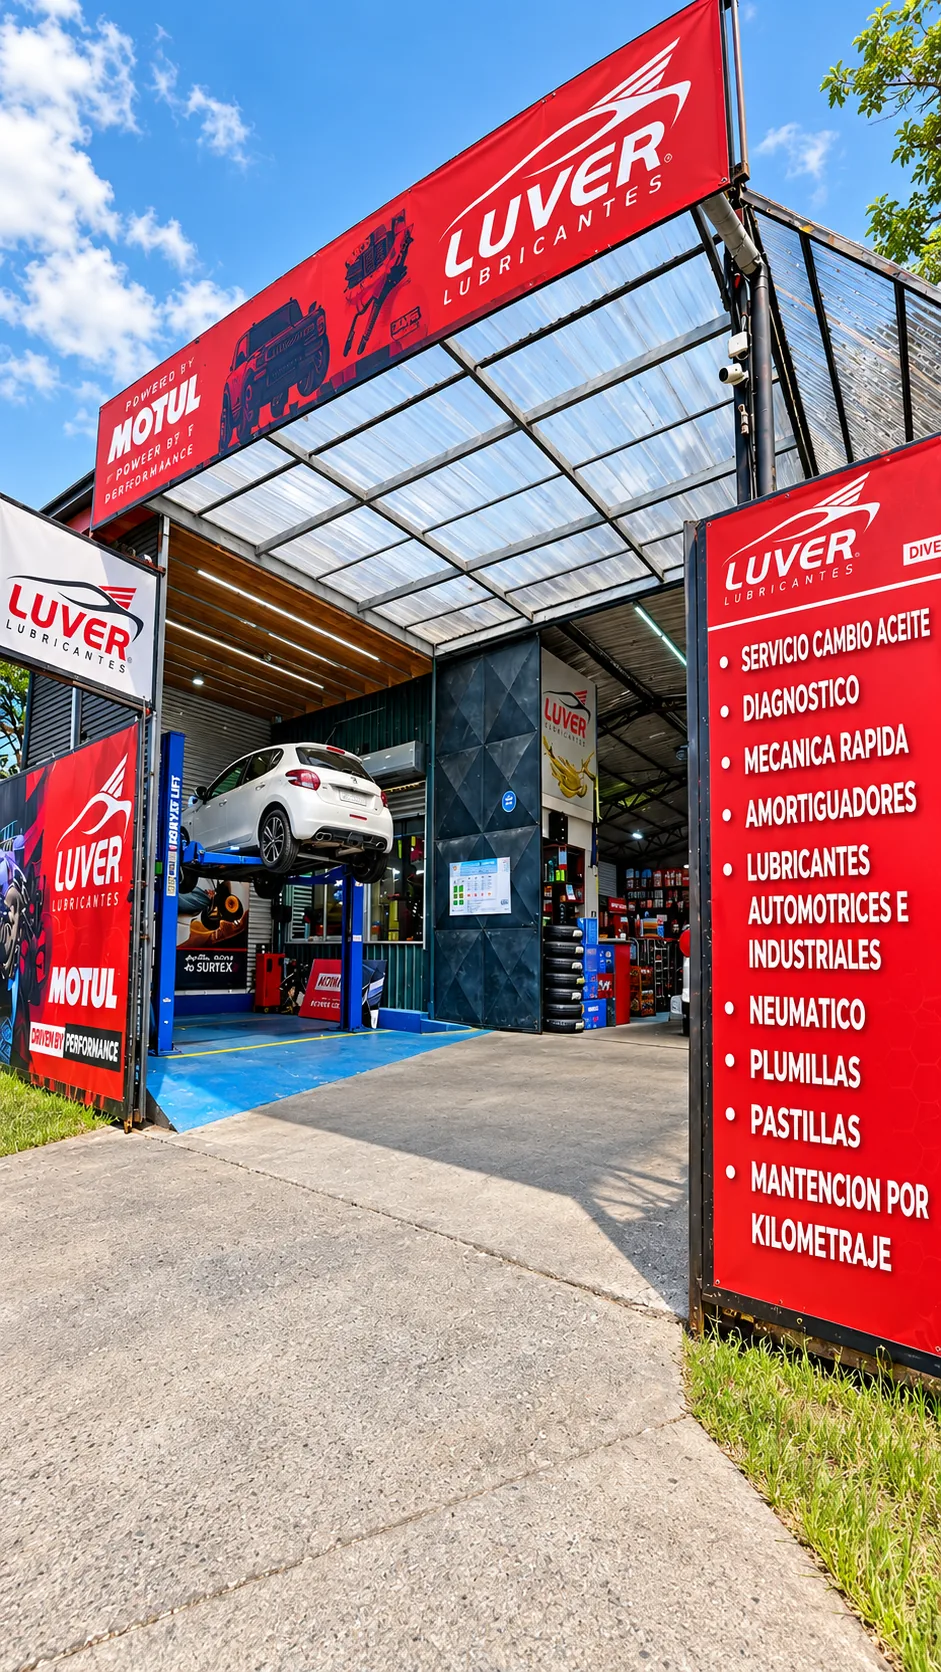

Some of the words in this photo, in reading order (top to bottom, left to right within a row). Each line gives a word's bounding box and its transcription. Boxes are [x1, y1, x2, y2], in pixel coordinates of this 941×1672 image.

[444, 121, 665, 277] LUVER
[443, 174, 662, 305] LUBRICANTES
[107, 373, 201, 465] MOTUL
[725, 528, 857, 591] LUVER
[724, 563, 853, 606] LUBRICANTES
[8, 583, 130, 661] LUVER
[741, 633, 810, 672] SERVICIO
[812, 620, 873, 658] CAMBIO
[876, 607, 931, 646] ACEITE
[6, 619, 126, 674] LUBRICANTES
[544, 697, 587, 739] LUVER
[743, 675, 860, 722] DIAGNOSTICO
[744, 735, 836, 775] MECANICA
[840, 723, 909, 762] RAPIDA
[745, 780, 917, 829] AMORTIGUADORES
[55, 835, 123, 892] LUVER
[747, 844, 870, 882] LUBRICANTES
[52, 891, 119, 913] LUBRICANTES
[748, 890, 891, 925] AUTOMOTRICES
[897, 890, 909, 923] E
[196, 962, 233, 973] SURTEX
[748, 938, 882, 971] INDUSTRIALES
[48, 966, 118, 1009] MOTUL
[749, 995, 866, 1031] NEUMATICO
[31, 1027, 54, 1049] DRIVEN
[54, 1031, 64, 1051] BY
[65, 1032, 119, 1063] PERFORMANCE
[750, 1048, 861, 1089] PLUMILLAS
[750, 1103, 861, 1149] PASTILLAS
[751, 1160, 881, 1213] MANTENCION
[887, 1179, 930, 1220] POR
[751, 1212, 892, 1272] KILOMETRAJE
